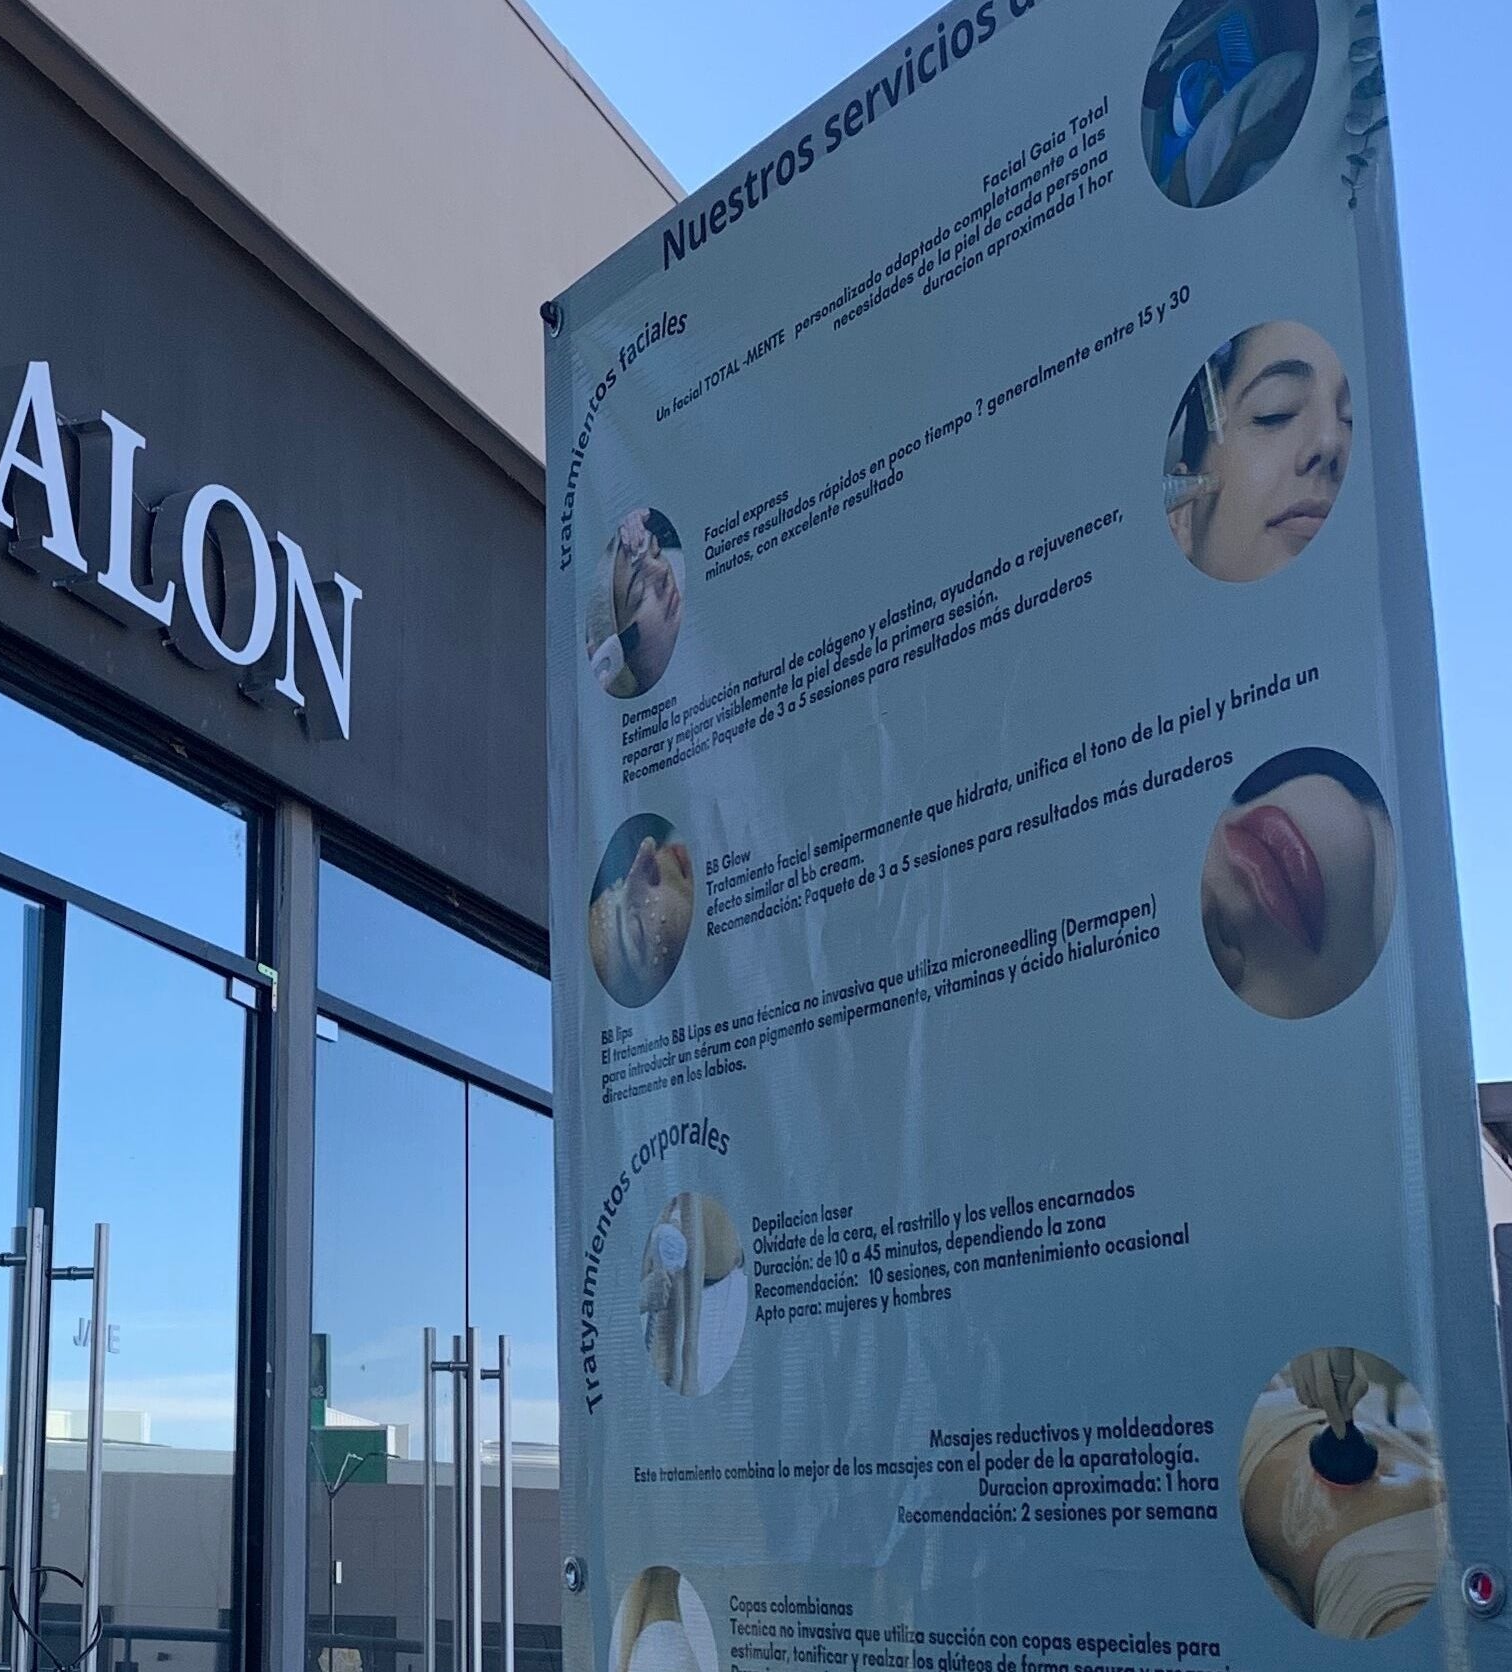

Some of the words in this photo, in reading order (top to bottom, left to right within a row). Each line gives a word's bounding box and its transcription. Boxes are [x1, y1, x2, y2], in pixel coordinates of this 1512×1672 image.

[662, 134, 814, 271] Nuestros
[825, 0, 997, 154] servicios
[983, 149, 1026, 193] Facial
[1030, 130, 1066, 161] Gaia
[1070, 95, 1108, 135] Total
[834, 272, 914, 331] necesidades
[918, 258, 934, 278] de
[938, 248, 950, 266] la
[955, 223, 979, 261] piel
[984, 216, 1001, 236] de
[1006, 191, 1042, 223] cada
[1047, 149, 1108, 203] persona
[923, 251, 983, 296] duracion
[987, 193, 1075, 257] aproximada
[1079, 183, 1084, 200] 1
[1088, 169, 1114, 195] hor
[656, 406, 670, 423] Un
[673, 380, 702, 413] facial
[704, 359, 740, 392] TOTAL
[795, 269, 882, 340] personalizado
[886, 226, 950, 277] adaptado
[954, 155, 1064, 233] completamente
[1069, 145, 1078, 160] a
[1082, 128, 1105, 152] las
[559, 368, 617, 571] tratamientos
[618, 311, 688, 372] faciales
[705, 530, 749, 561] Quieres
[753, 495, 816, 538] resultados
[819, 468, 866, 503] rápidos
[870, 457, 885, 475] en
[889, 439, 921, 471] poco
[925, 411, 972, 445] tiempo
[987, 346, 1090, 417] generalmente
[1094, 321, 1134, 353] entre
[1138, 304, 1152, 328] 15
[1156, 302, 1166, 324] y
[1170, 284, 1190, 310] 30
[704, 510, 739, 542] Facial
[743, 490, 788, 523] express
[706, 550, 753, 582] minutos,
[757, 536, 778, 555] con
[781, 504, 839, 543] excelente
[843, 466, 903, 511] resultado
[622, 696, 676, 728] Dermapen
[706, 862, 774, 896] Tratamiento
[777, 843, 810, 871] facial
[814, 808, 923, 858] semipermanente
[926, 799, 952, 822] que
[956, 778, 1012, 807] hidrata,
[1016, 756, 1068, 786] unifica
[1073, 743, 1086, 765] el
[1091, 735, 1127, 759] tono
[1132, 723, 1153, 744] de
[1158, 716, 1174, 736] la
[1179, 699, 1211, 735] piel
[1215, 699, 1226, 721] y
[1230, 675, 1291, 710] brinda
[1296, 666, 1319, 686] un
[722, 850, 751, 870] Glow
[817, 1249, 831, 1269] de
[835, 1247, 848, 1266] 10
[852, 1251, 860, 1264] a
[864, 1243, 881, 1262] 45
[885, 1239, 941, 1259] minutos,
[946, 1219, 1043, 1254] dependiendo
[1048, 1216, 1062, 1236] la
[1067, 1215, 1106, 1234] zona
[821, 1203, 853, 1222] laser
[580, 1170, 631, 1416] Tratyamientos
[631, 1117, 730, 1175] corporales
[755, 1270, 858, 1300] Recomendación:
[869, 1266, 883, 1285] 10
[887, 1263, 949, 1283] sesiones,
[954, 1258, 979, 1274] con
[984, 1239, 1100, 1270] mantenimiento
[1105, 1225, 1189, 1255] ocasional
[755, 1304, 785, 1326] Apto
[789, 1302, 822, 1324] para:
[826, 1294, 877, 1318] mujeres
[881, 1295, 889, 1314] y
[893, 1283, 952, 1306] hombres
[930, 1427, 992, 1452] Masajes
[996, 1422, 1079, 1444] reductivos
[1083, 1426, 1092, 1446] y
[1097, 1416, 1214, 1440] moldeadores
[979, 1477, 1048, 1497] Duracion
[1053, 1473, 1161, 1500] aproximada:
[1167, 1472, 1172, 1492] 1
[1178, 1472, 1219, 1492] hora
[1021, 1502, 1030, 1522] 2
[1035, 1501, 1107, 1522] sesiones
[1112, 1506, 1141, 1527] por
[1146, 1505, 1217, 1520] semana
[729, 1595, 767, 1619] Copas
[770, 1594, 853, 1616] colombianas
[780, 1625, 794, 1638] no
[798, 1621, 851, 1641] invasiva
[855, 1628, 880, 1647] que
[929, 1626, 986, 1647] succión
[990, 1633, 1017, 1648] con
[1022, 1635, 1071, 1656] copas
[1076, 1634, 1171, 1658] especiales
[1177, 1641, 1220, 1662] para
